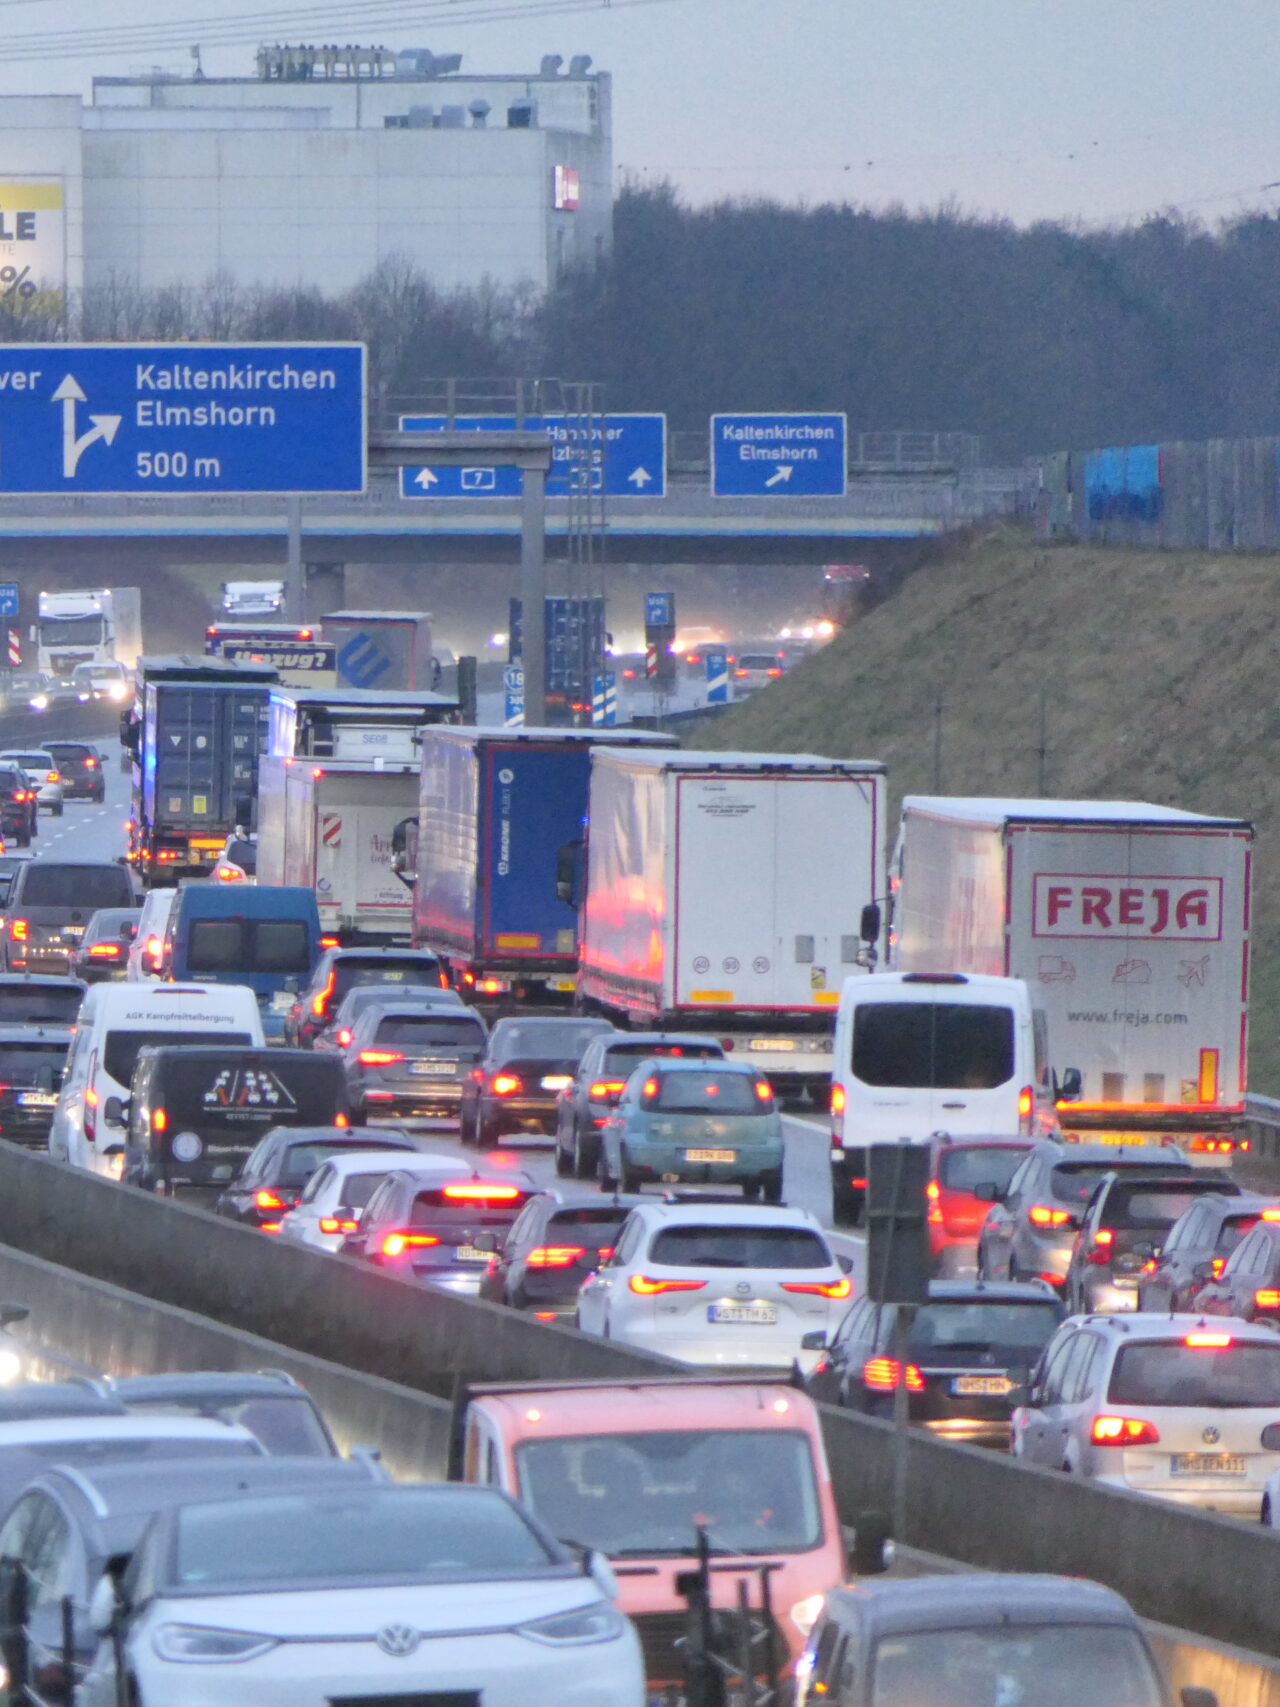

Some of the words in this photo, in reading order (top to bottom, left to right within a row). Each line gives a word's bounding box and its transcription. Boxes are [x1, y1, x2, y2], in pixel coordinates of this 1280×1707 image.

[136, 364, 336, 390] Kaltenkirchen
[136, 401, 276, 426] Elmshorn
[723, 424, 835, 441] Kaltenkirchen
[739, 445, 818, 460] Elmshorn
[136, 452, 188, 478] 500
[194, 457, 221, 477] m
[474, 472, 483, 486] 7
[1047, 887, 1210, 934] FREJA
[1067, 1009, 1189, 1026] www.freja.com
